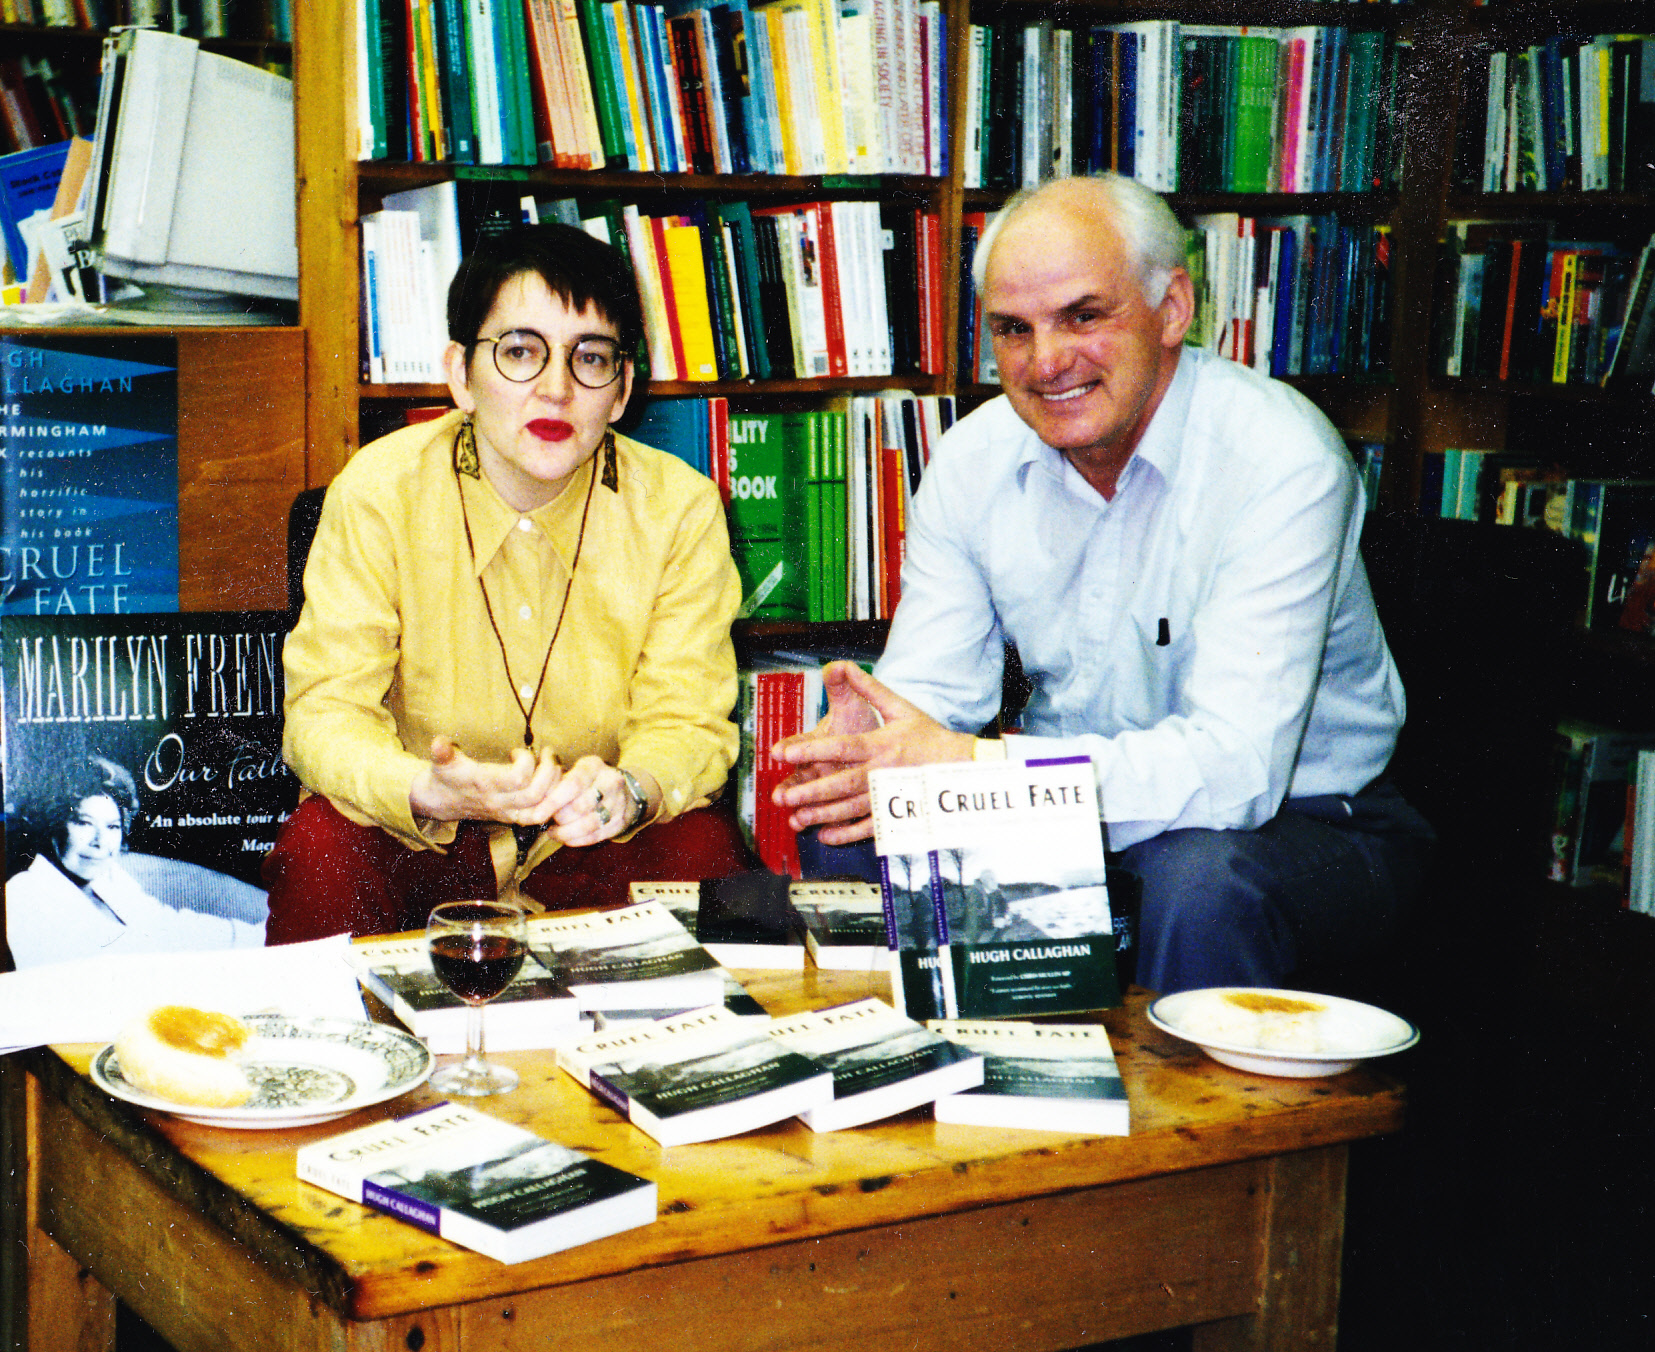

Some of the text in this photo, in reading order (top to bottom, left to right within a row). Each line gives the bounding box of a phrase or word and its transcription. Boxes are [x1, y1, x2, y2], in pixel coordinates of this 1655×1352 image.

[8, 351, 43, 368] GH
[6, 376, 133, 394] LLAGHAN
[19, 448, 92, 458] recounts
[19, 467, 43, 478] his
[19, 487, 87, 498] horrific
[20, 507, 87, 519] story in
[21, 527, 92, 539] his book
[34, 584, 131, 616] FATE
[16, 632, 290, 723] MARILYN FREN
[144, 733, 218, 791] Our
[938, 784, 1085, 814] CRUEL FATE
[178, 813, 241, 827] absolute
[246, 814, 274, 824] tour
[541, 922, 591, 932] RUEL
[570, 953, 685, 973] HUGH CALLAGHAN
[970, 944, 1091, 964] HUGH CALLAGHAN
[769, 1007, 878, 1037] UEL FATE
[575, 1013, 720, 1052] CRUEL FATE
[934, 1027, 1093, 1039] CRUEL FATE
[856, 1049, 934, 1076] CALLAGHAN
[656, 1085, 699, 1100] HUGH
[701, 1062, 781, 1090] CALLAGHAN
[328, 1114, 470, 1161] CRUEL FATE
[365, 1188, 437, 1225] HUGH CALLAGHAN
